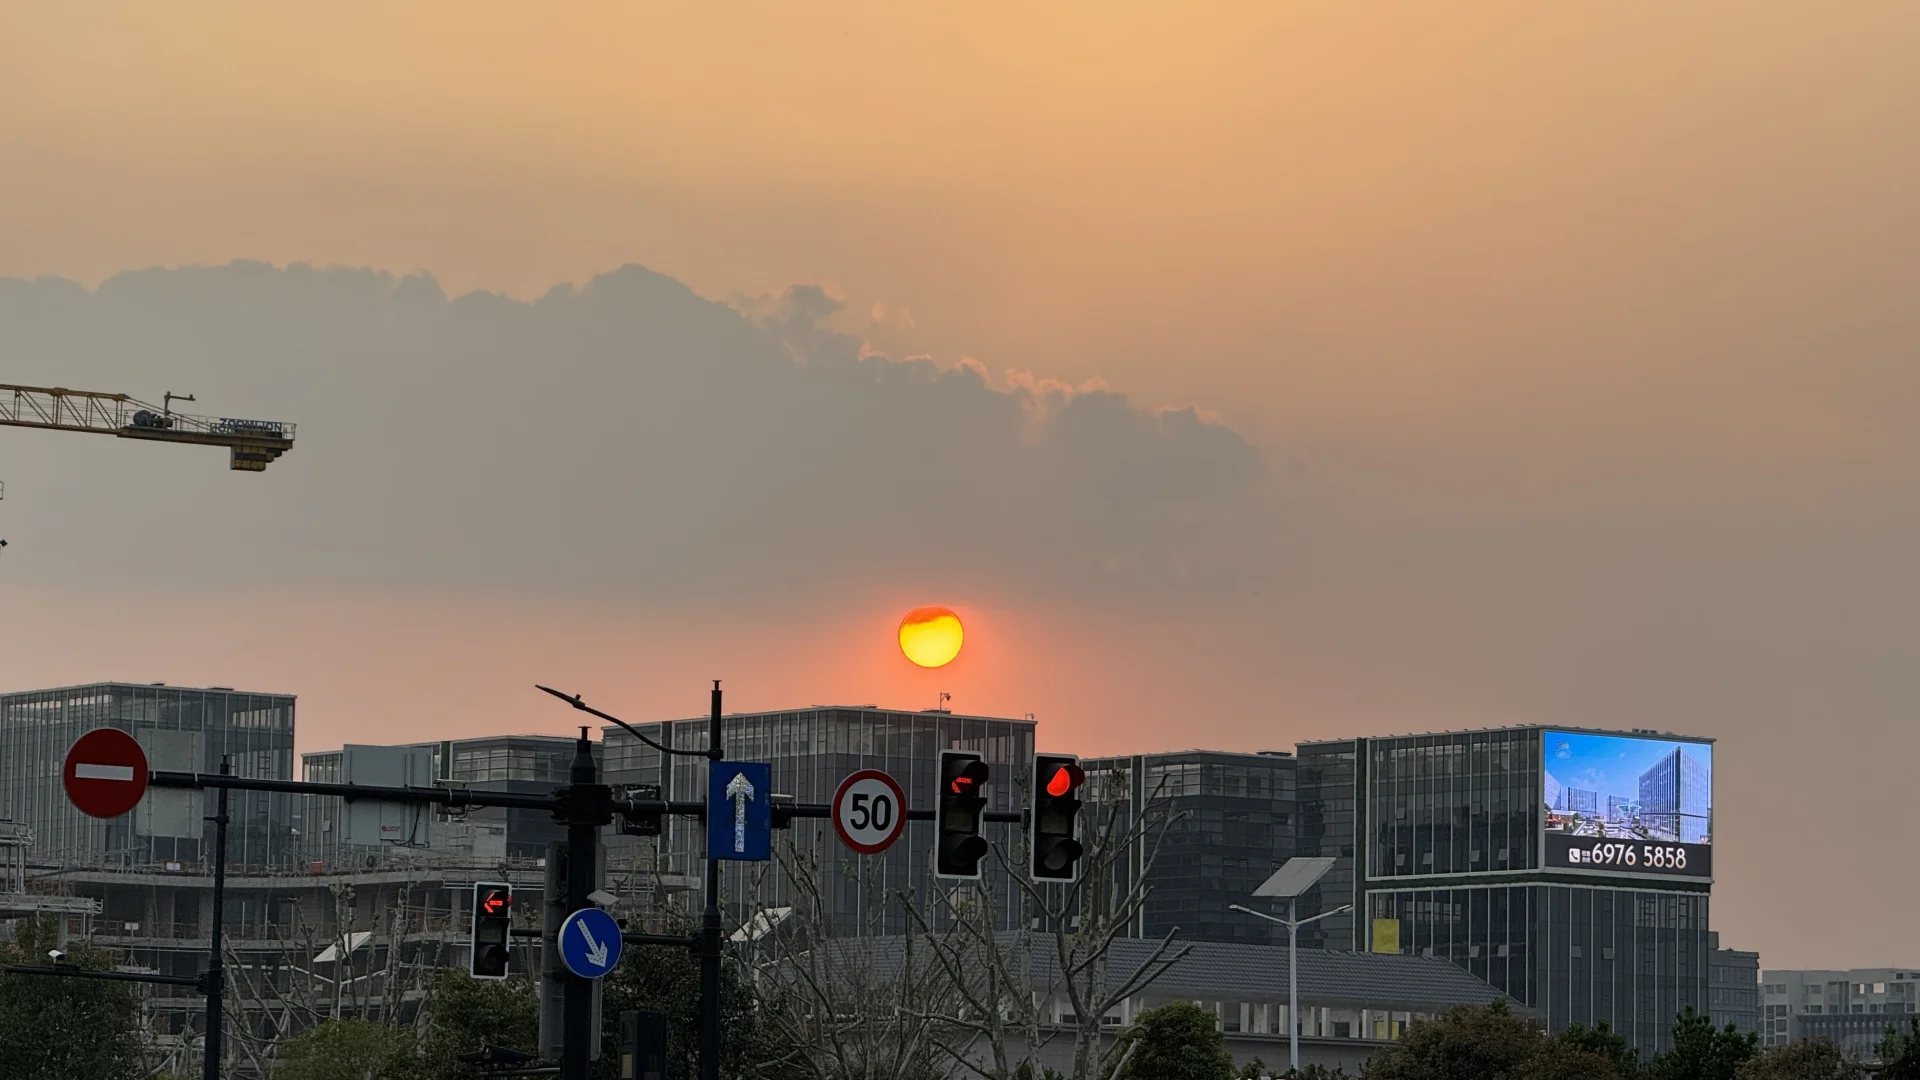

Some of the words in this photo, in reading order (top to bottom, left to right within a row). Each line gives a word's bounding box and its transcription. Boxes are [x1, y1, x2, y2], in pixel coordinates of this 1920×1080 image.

[220, 418, 282, 432] ZOOMLION
[850, 793, 892, 831] 50
[1592, 843, 1636, 866] 6976
[1643, 845, 1686, 869] 5858
